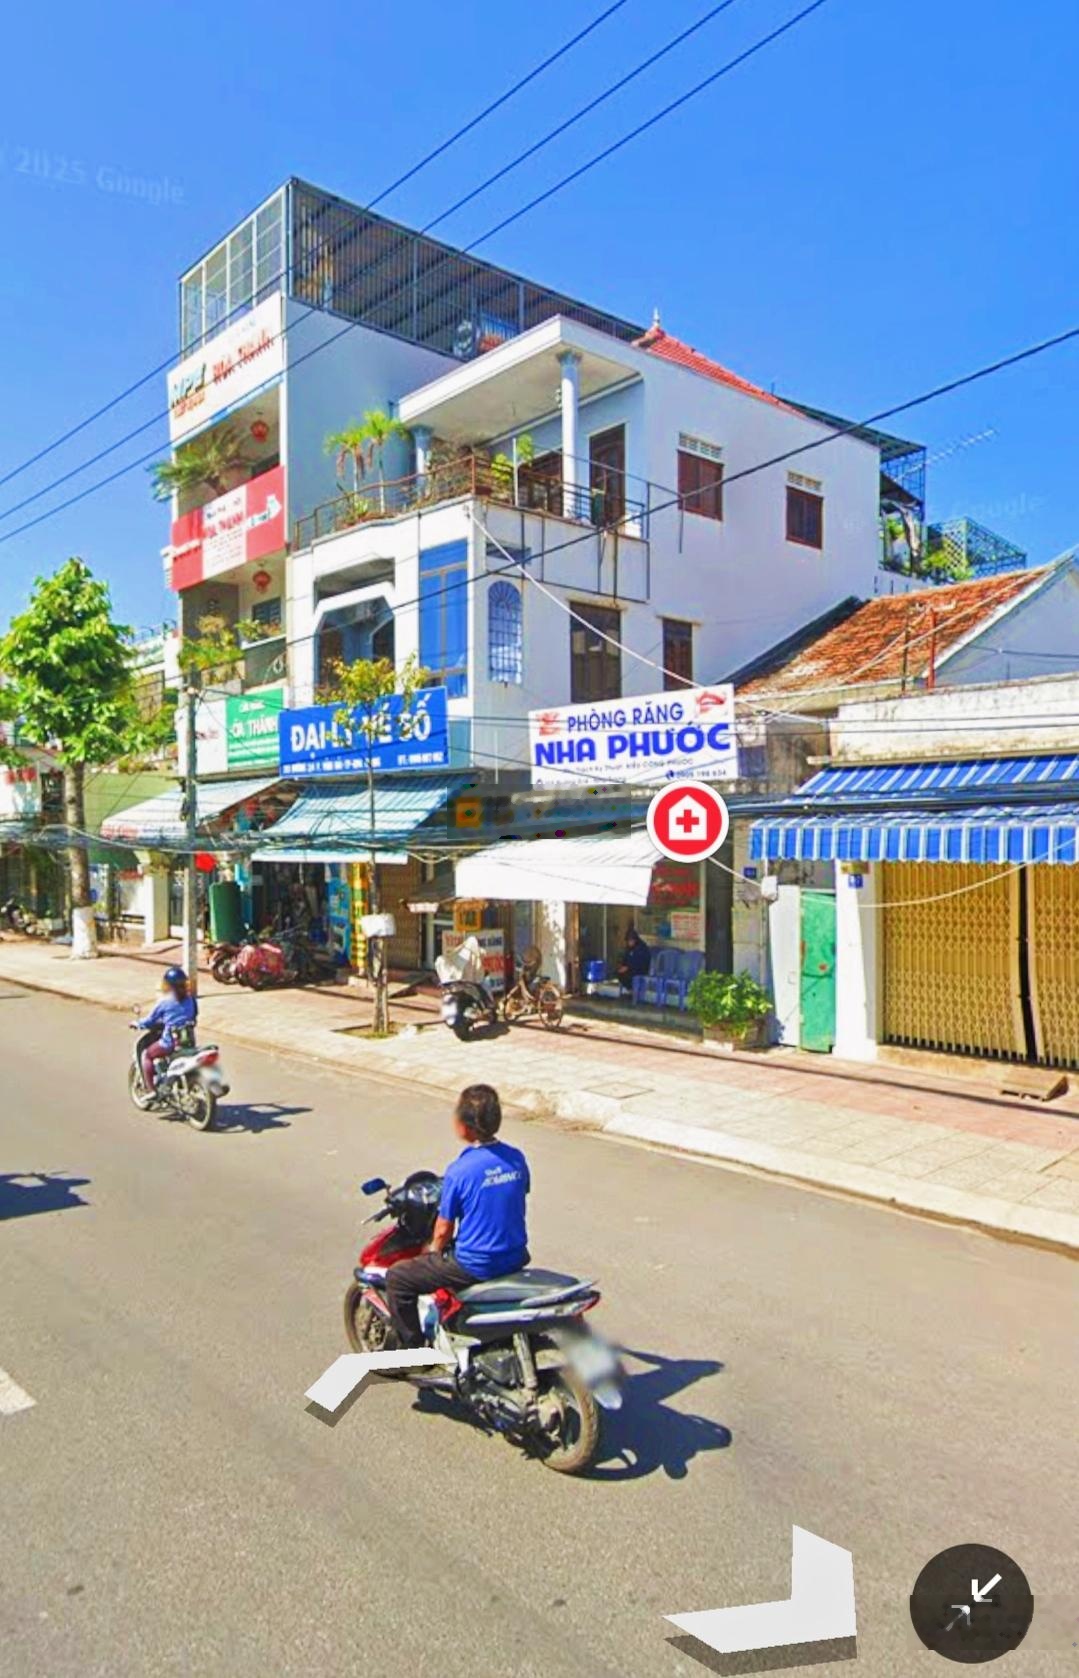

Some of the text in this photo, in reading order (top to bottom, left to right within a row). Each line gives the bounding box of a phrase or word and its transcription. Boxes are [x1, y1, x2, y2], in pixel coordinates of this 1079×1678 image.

[290, 721, 326, 760] ĐẠI
[399, 693, 432, 742] SỐ
[567, 701, 684, 733] PHÒNG RĂNG
[535, 721, 731, 766] NHA PHƯỚC
